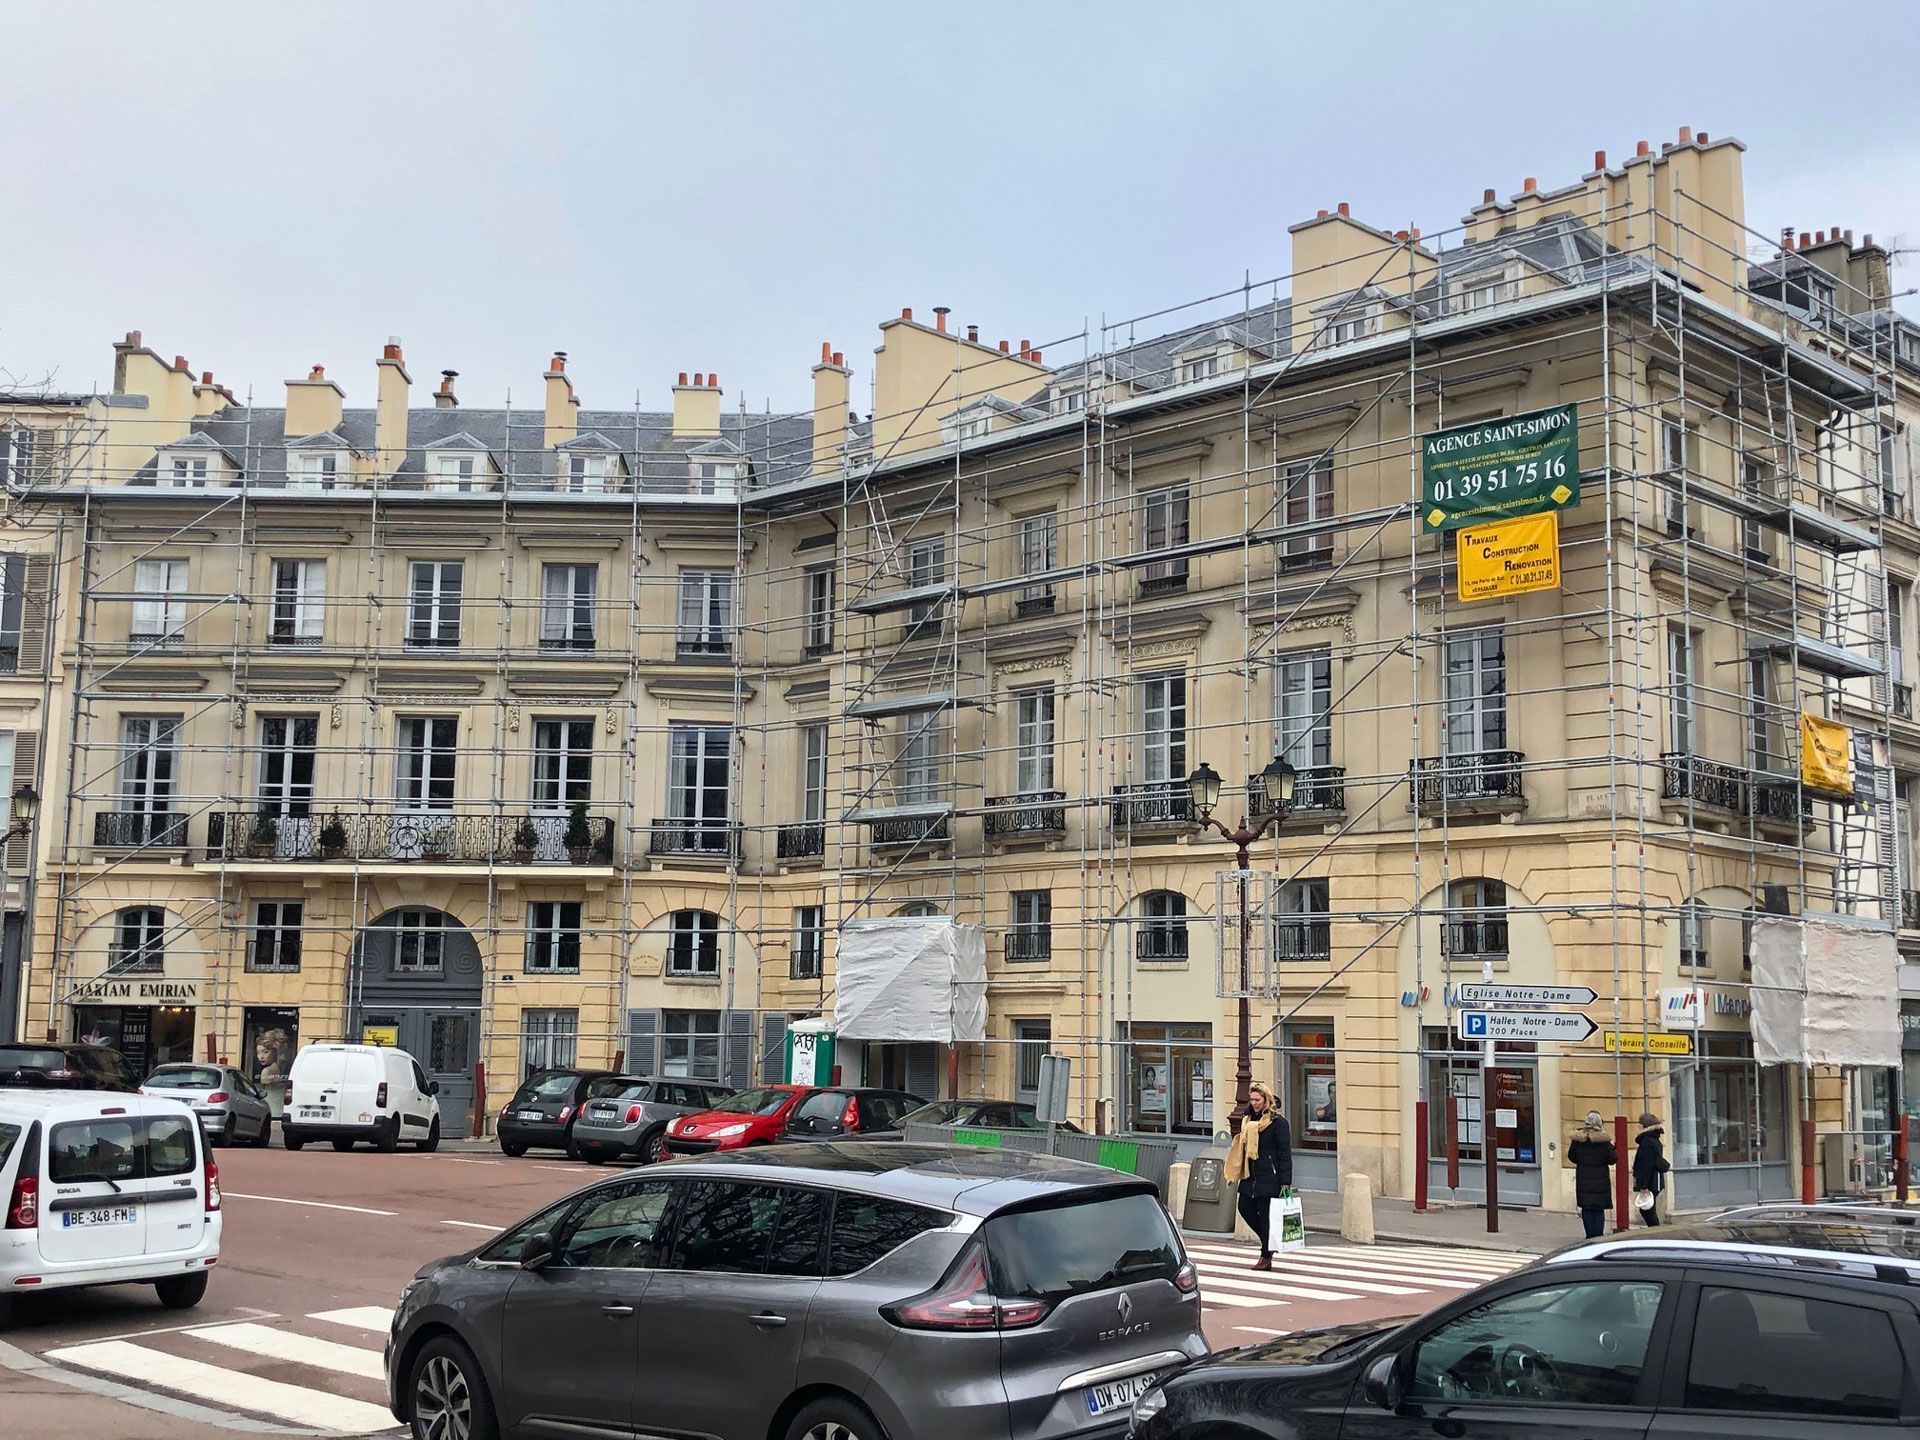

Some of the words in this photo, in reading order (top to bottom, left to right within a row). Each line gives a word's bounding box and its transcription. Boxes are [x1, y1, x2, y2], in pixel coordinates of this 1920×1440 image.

[1427, 431, 1482, 455] AGENCE
[1484, 411, 1571, 444] SAINT-SIMON
[1434, 479, 1453, 501] 01
[1460, 474, 1482, 497] 39
[1487, 468, 1507, 491] 51
[1515, 462, 1538, 485] 75
[1543, 455, 1566, 480] 16
[1464, 534, 1498, 547] TRAVAUX
[1483, 543, 1539, 559] CONSTRUCTION
[1504, 557, 1552, 572] RENOVATION
[140, 983, 197, 997] EMIRIAN
[1466, 988, 1500, 1000] Eglise
[1472, 1017, 1481, 1031] P
[1490, 1016, 1517, 1026] Halles
[1490, 1028, 1506, 1036] 700
[1510, 1028, 1538, 1036] Places
[1609, 1037, 1645, 1048] Itnéraire
[1648, 1039, 1686, 1049] Conseillé
[71, 1208, 128, 1225] BE-348-FM
[1099, 1321, 1150, 1341] ESPACE
